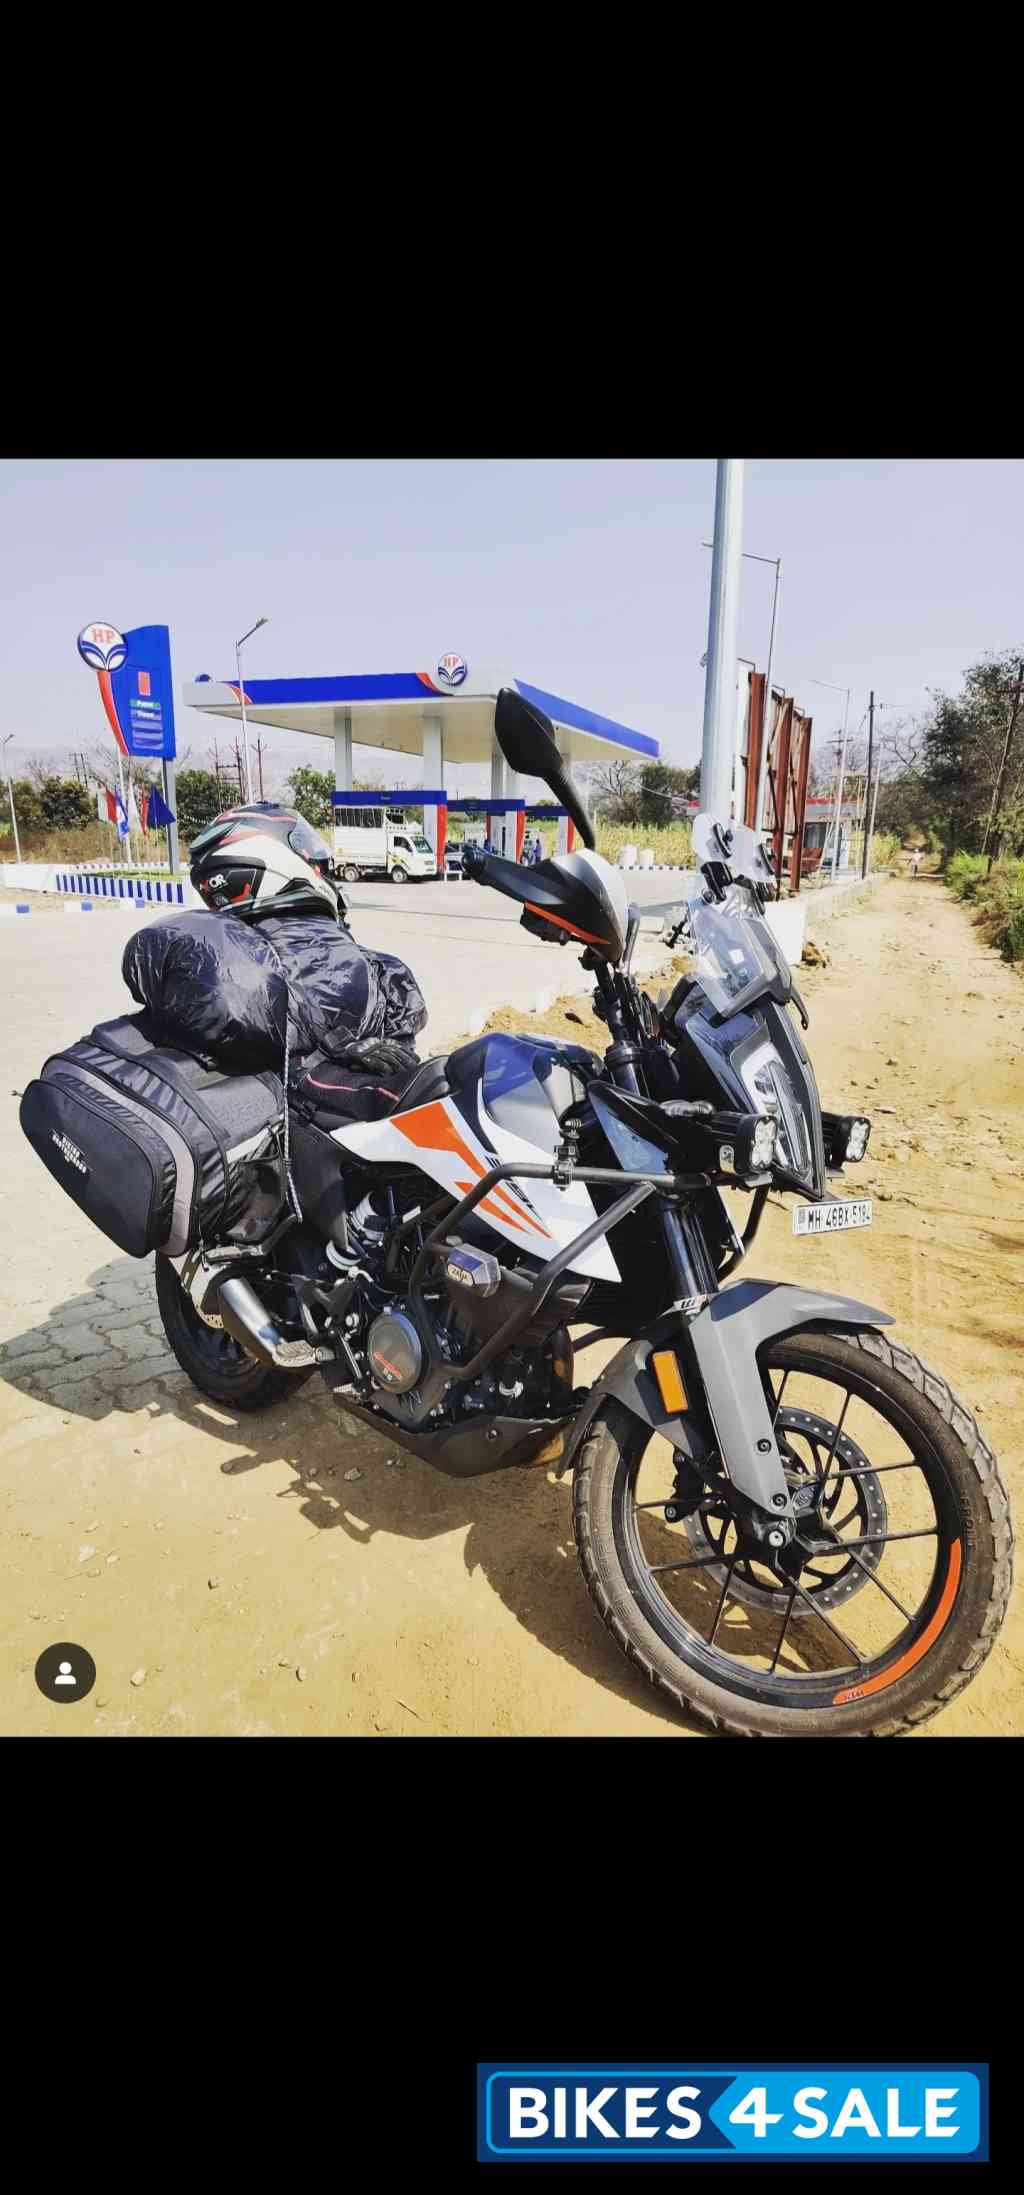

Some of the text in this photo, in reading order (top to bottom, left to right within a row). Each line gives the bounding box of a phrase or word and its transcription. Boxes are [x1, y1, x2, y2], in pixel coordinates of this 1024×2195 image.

[92, 628, 116, 644] HP
[443, 655, 460, 668] HP
[808, 1209, 821, 1229] MH
[826, 1206, 848, 1228] 46BX
